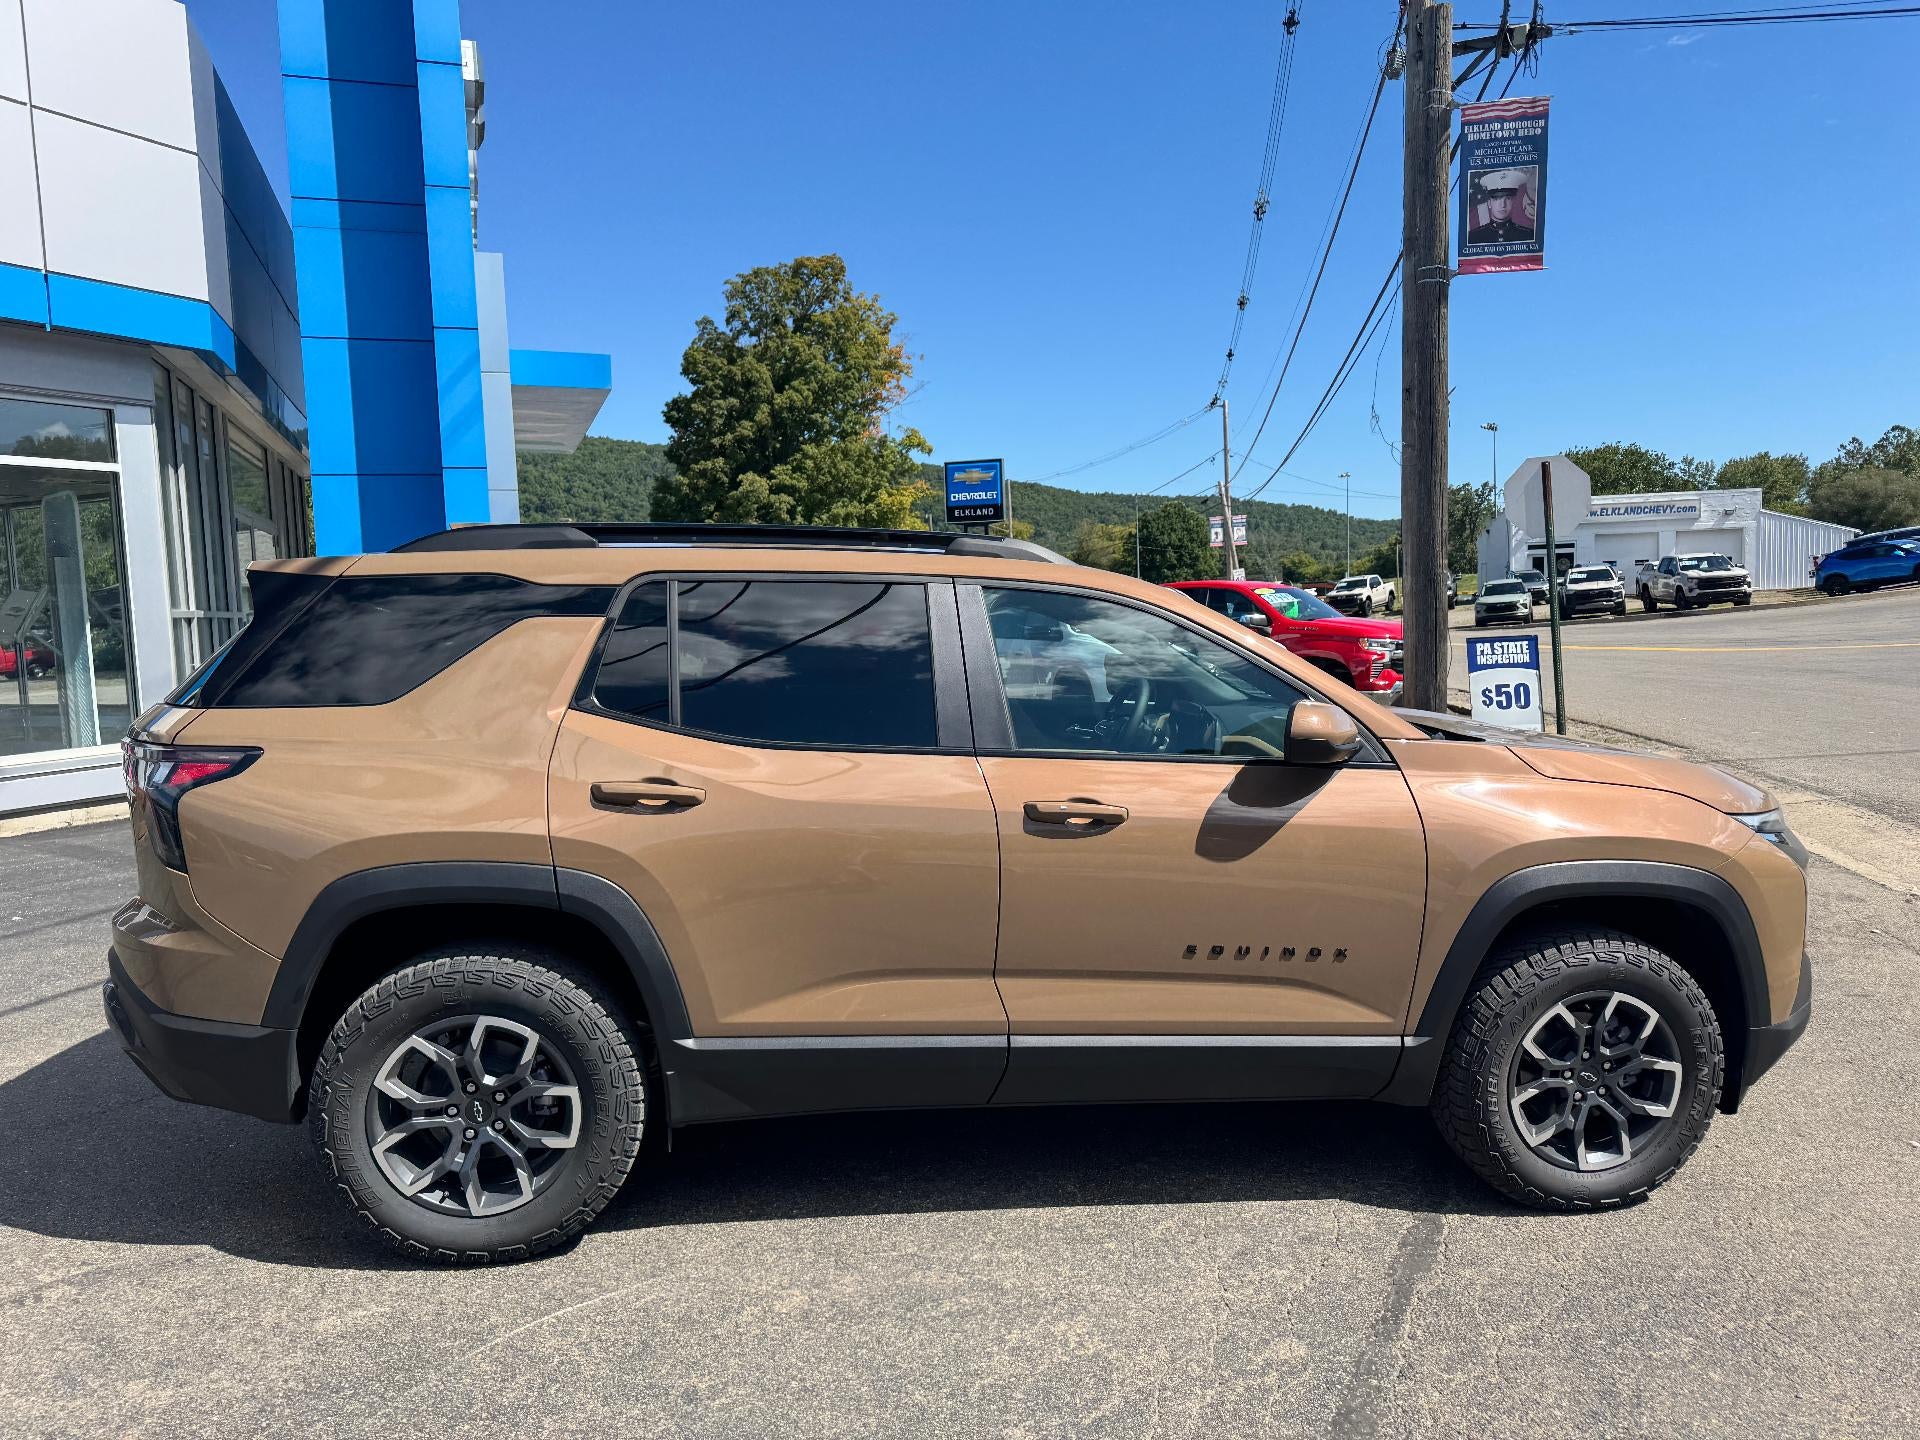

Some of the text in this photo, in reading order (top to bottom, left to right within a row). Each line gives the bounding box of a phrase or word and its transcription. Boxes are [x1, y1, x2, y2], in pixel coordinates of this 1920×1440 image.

[1464, 119, 1545, 134] ELKLAND BOROUGH
[1467, 127, 1542, 141] HOMETOWN HERO
[1474, 144, 1533, 156] MICHAEL PLANK
[1483, 156, 1513, 165] MARINE
[1514, 153, 1538, 162] CORPS
[951, 491, 997, 501] CHEVROLET
[954, 507, 994, 517] ELKLAND
[1476, 641, 1529, 655] PA STATE
[1477, 653, 1530, 665] INSPECTION
[1481, 682, 1531, 710] $50
[1185, 944, 1348, 960] EQUINOX
[333, 1069, 383, 1208] GENERAL
